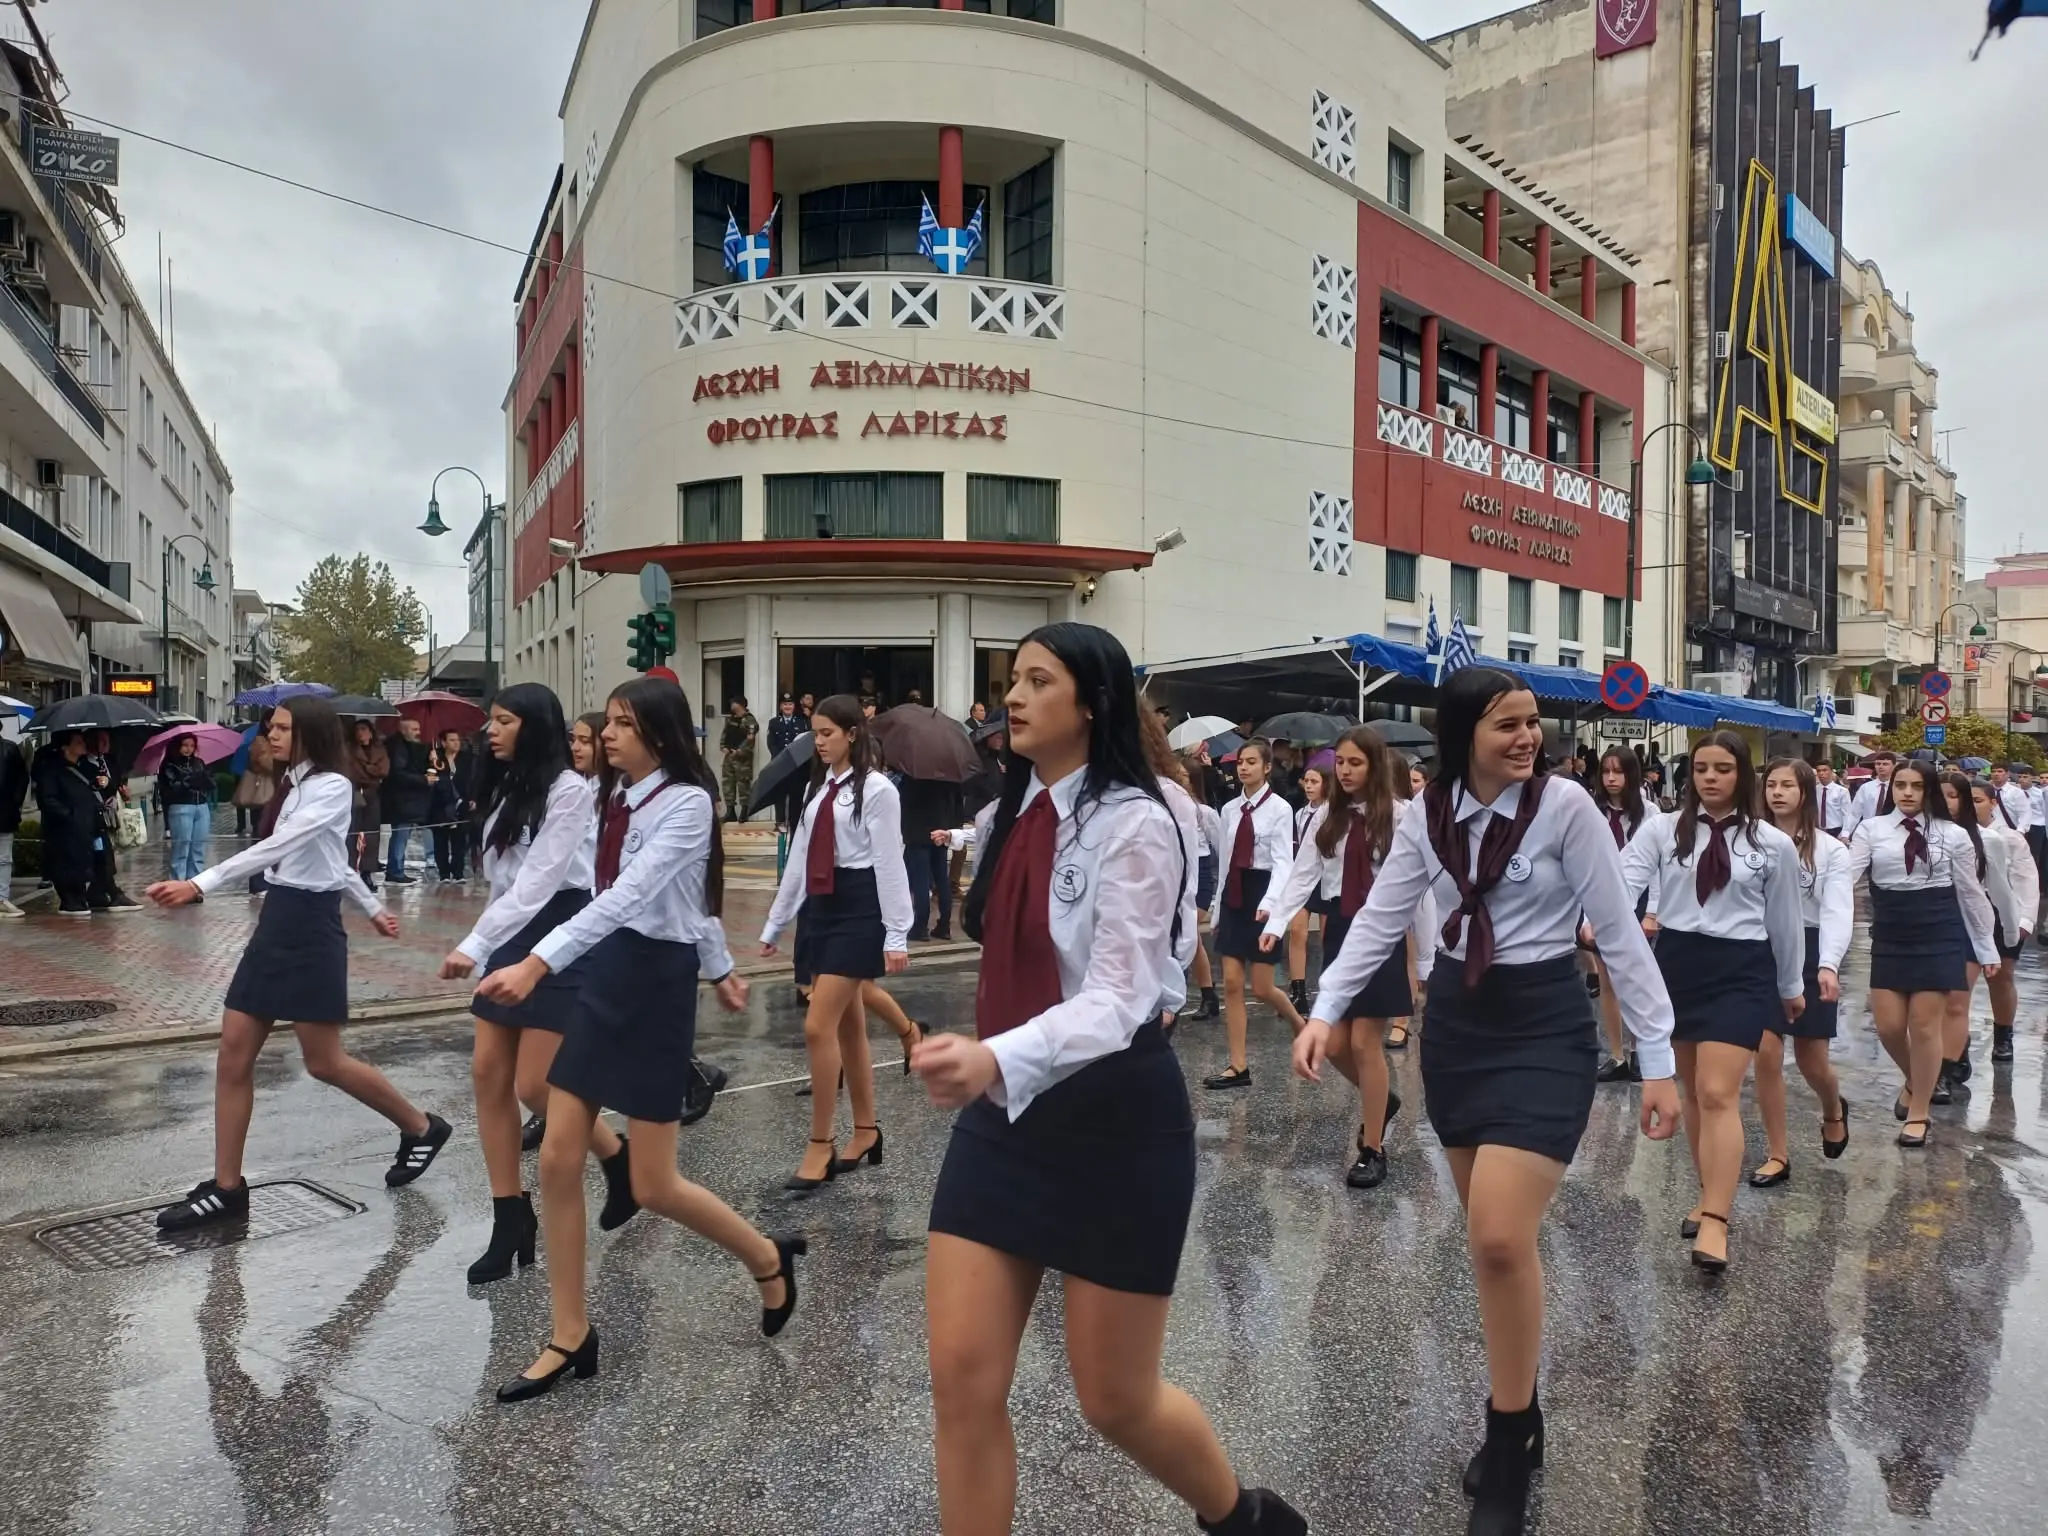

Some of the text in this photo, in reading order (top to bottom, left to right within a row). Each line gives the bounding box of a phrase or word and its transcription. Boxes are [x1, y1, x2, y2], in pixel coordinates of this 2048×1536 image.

[35, 137, 116, 155] ΠΟΛΥΚΑΤΟΙΚΙΩΝ
[48, 130, 104, 144] ΔΙΑΧΕΙΡΙΣΗ
[692, 360, 1030, 402] ΛΕΣΧΗ ΑΞΙΩΜΑΤΙΚΩΝ
[1796, 385, 1832, 425] ALTERLIFE
[706, 410, 1008, 445] ΦΡΟΥΡΑΣ ΛΑΡΙΣΑΣ
[1462, 490, 1582, 540] ΛΕΣΧΗ ΑΞΙΩΜΑΤΙΚΩΝ
[1469, 524, 1574, 566] ΦΡΟΥΡΑΣ ΛΑΡΙΣΑΣ
